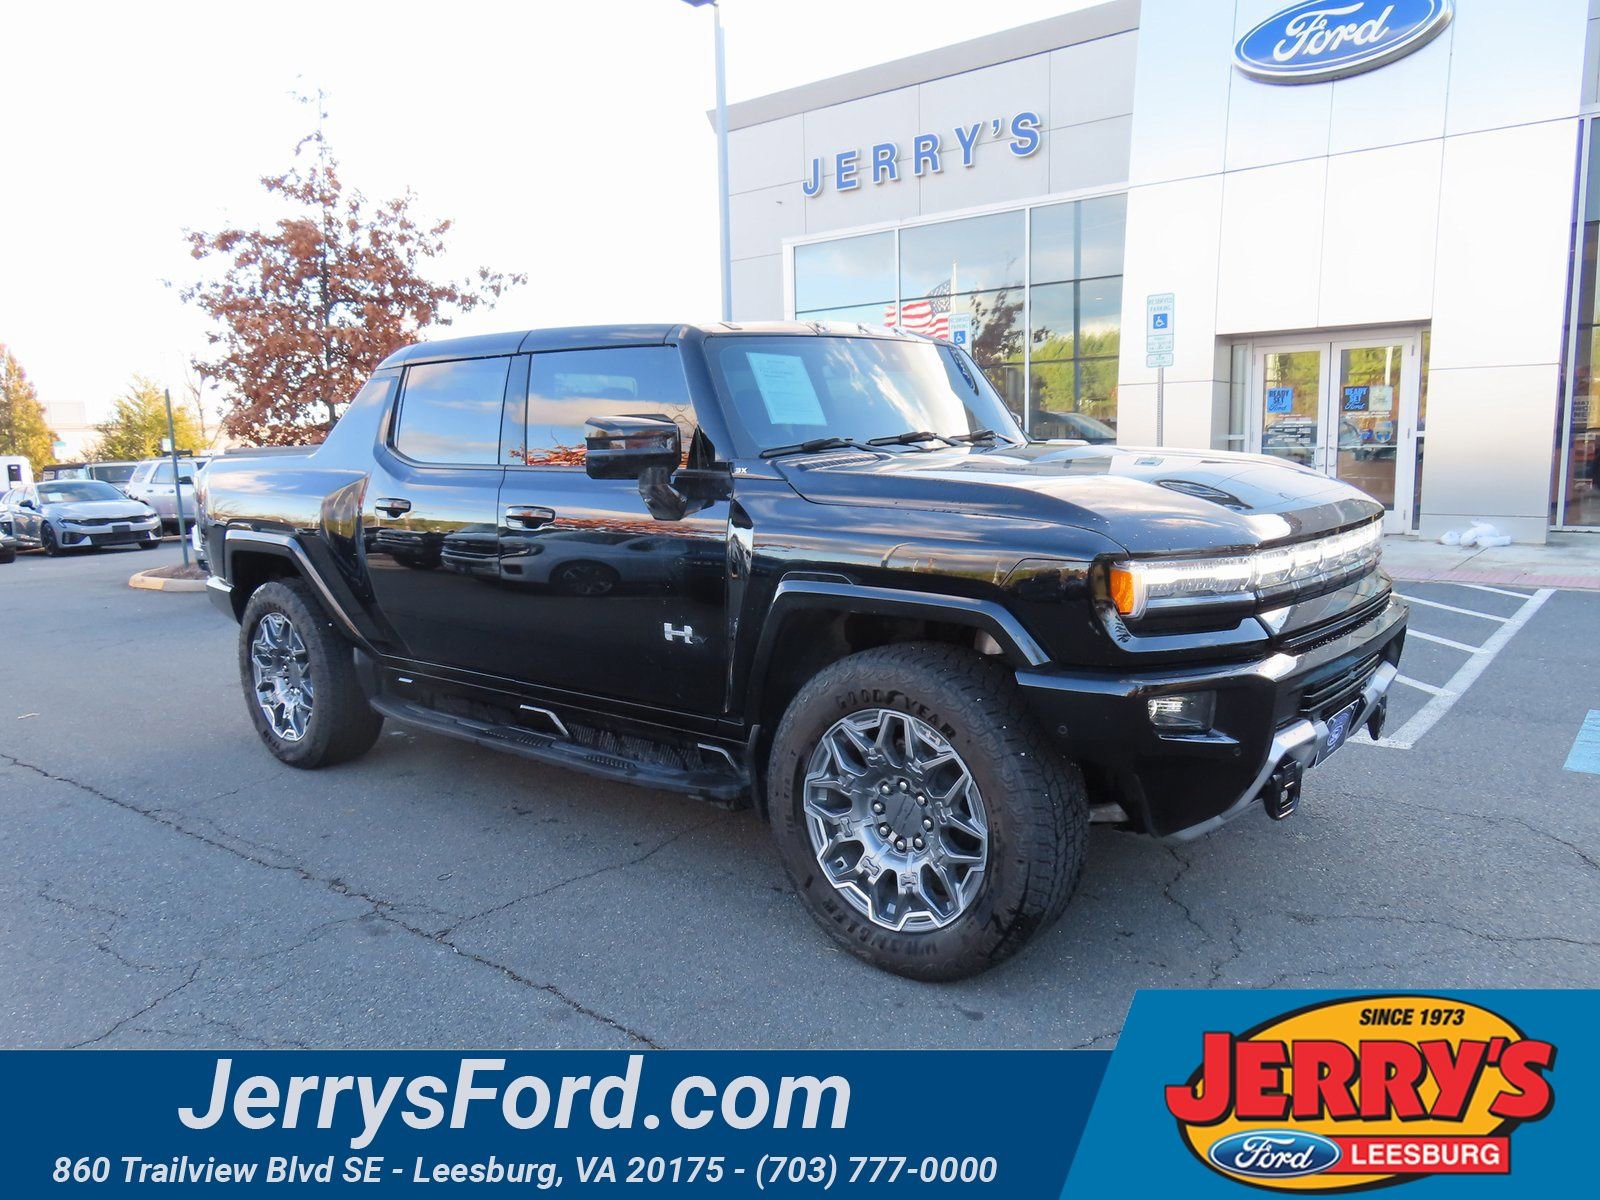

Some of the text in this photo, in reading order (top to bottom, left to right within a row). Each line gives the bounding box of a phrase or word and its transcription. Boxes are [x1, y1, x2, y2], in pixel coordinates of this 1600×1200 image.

[1272, 2, 1395, 62] Ford
[803, 112, 1041, 196] JERRY'S
[1269, 390, 1290, 398] READY
